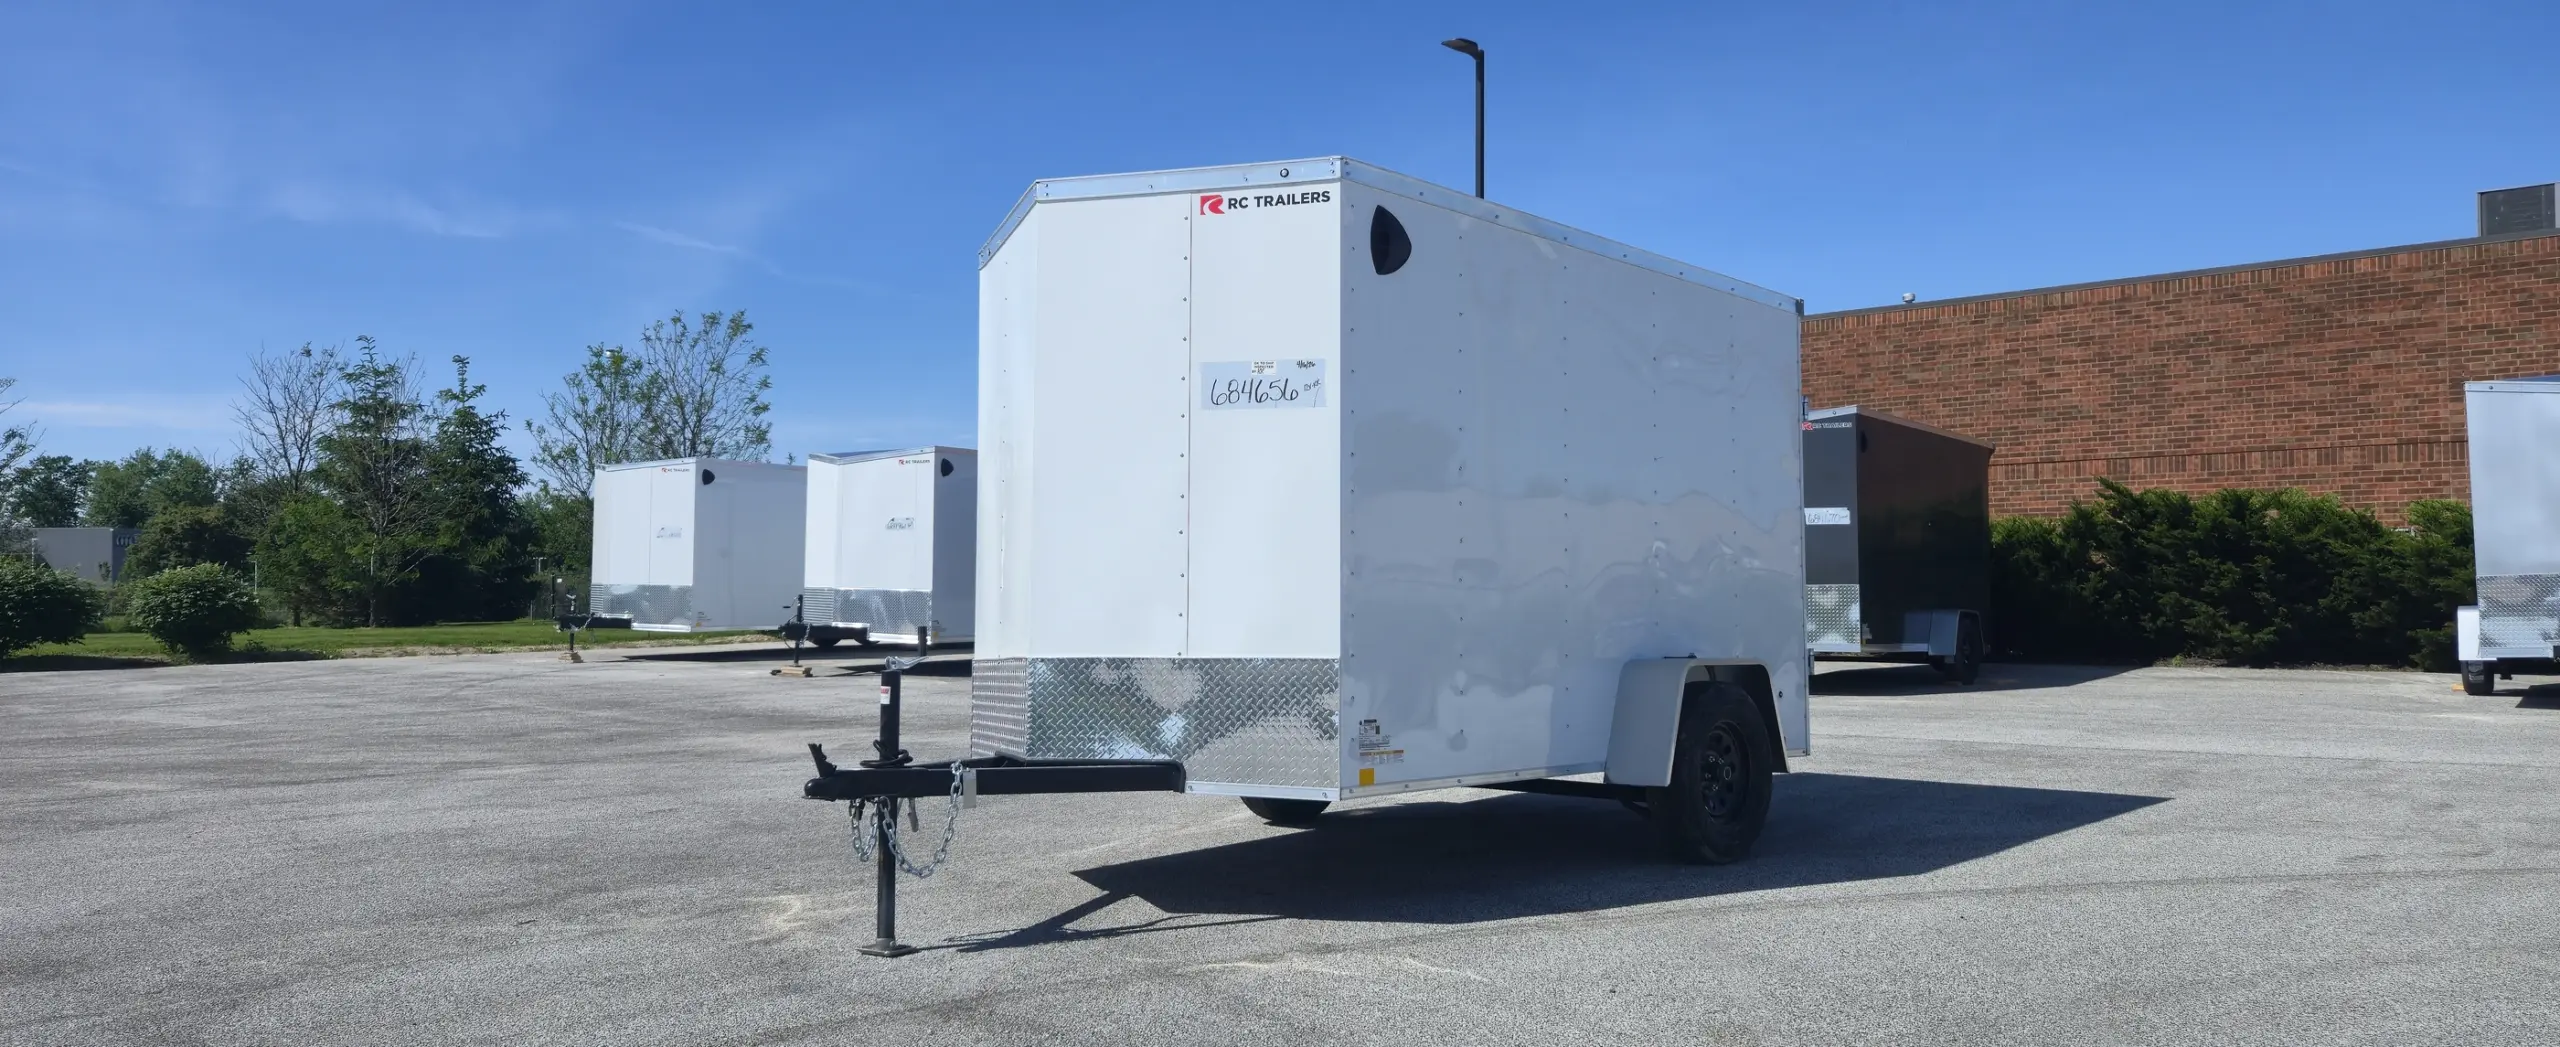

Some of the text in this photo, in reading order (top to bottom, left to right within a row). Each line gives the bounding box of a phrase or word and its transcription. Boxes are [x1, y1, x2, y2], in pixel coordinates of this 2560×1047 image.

[1227, 197, 1249, 210] RC
[1253, 190, 1331, 208] TRAILERS
[1210, 378, 1299, 406] 684656
